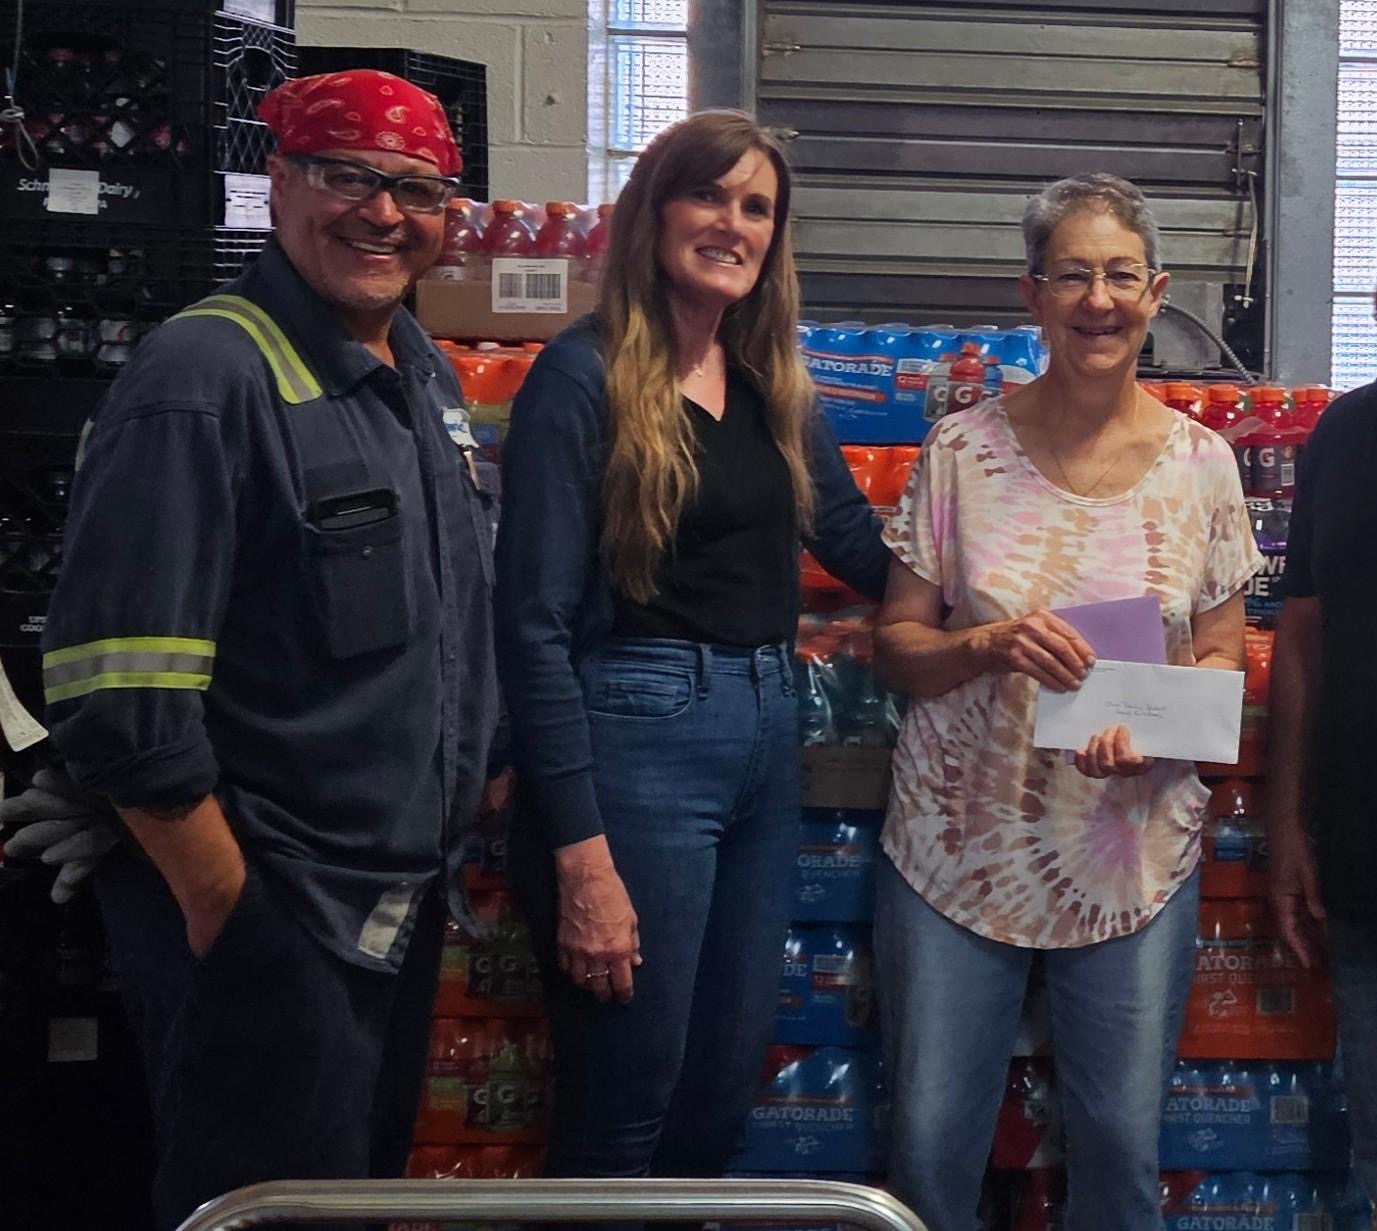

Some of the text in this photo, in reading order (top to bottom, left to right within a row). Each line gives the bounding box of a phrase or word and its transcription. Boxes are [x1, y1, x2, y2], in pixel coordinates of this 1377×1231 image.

[955, 386, 973, 404] G
[1259, 447, 1275, 468] G
[797, 855, 862, 868] ORADE
[1197, 955, 1297, 970] ATORDE
[1166, 1097, 1251, 1112] ATORADE
[752, 1106, 853, 1122] GATORADE
[1177, 1216, 1275, 1231] GATORADE
